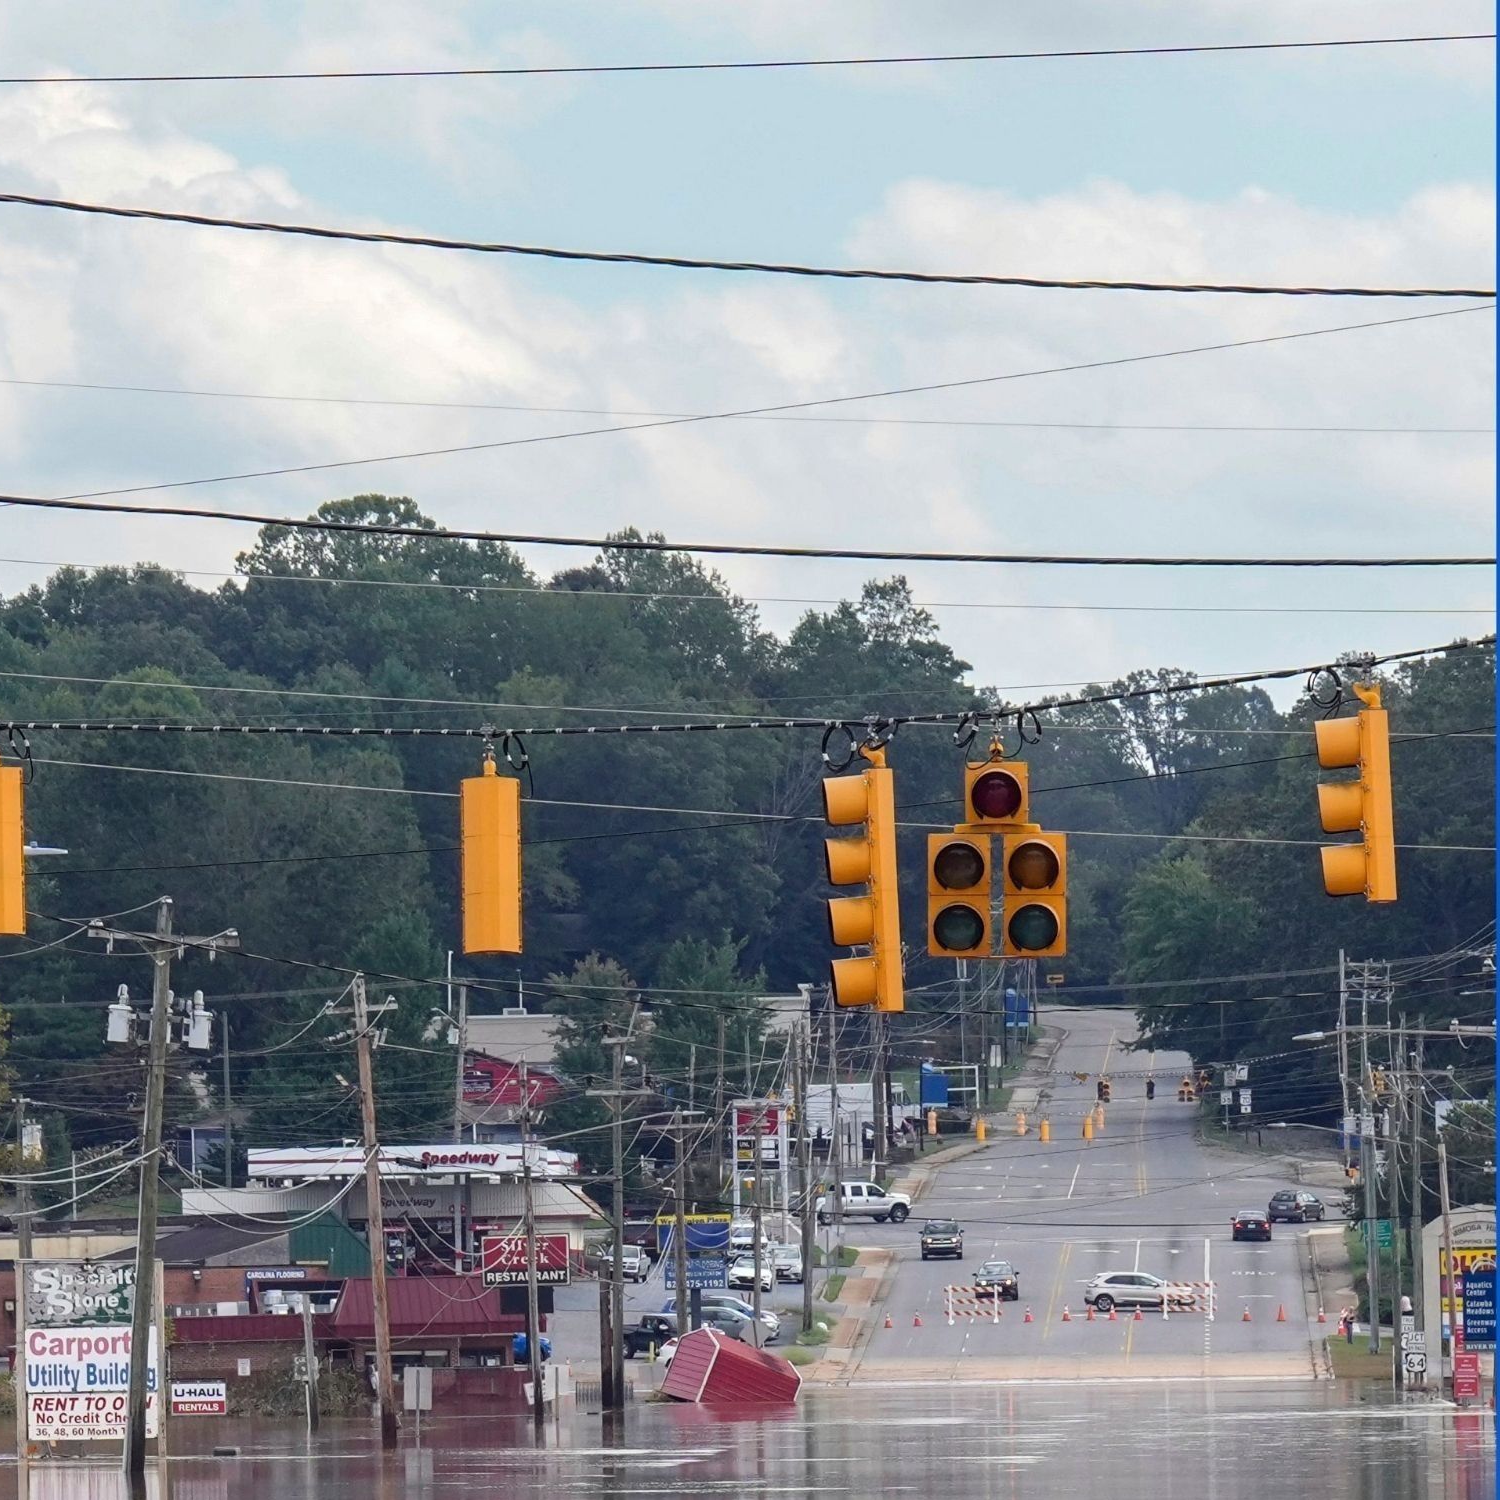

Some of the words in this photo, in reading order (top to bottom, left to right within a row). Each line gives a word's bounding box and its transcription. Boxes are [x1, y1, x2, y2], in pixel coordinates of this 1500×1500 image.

[422, 1152, 500, 1166] Speedway
[33, 1268, 136, 1293] Specialt
[246, 1271, 276, 1279] CAROLINA
[276, 1271, 305, 1279] FLOORING
[1466, 1281, 1492, 1289] Aquatics
[1466, 1289, 1487, 1297] Center
[46, 1290, 120, 1315] Stone
[1466, 1319, 1497, 1327] Greenway
[1409, 1333, 1424, 1342] JCT
[29, 1331, 131, 1361] Carport
[1408, 1358, 1424, 1369] 64
[28, 1364, 80, 1391] Utility
[86, 1362, 156, 1392] Buildg
[32, 1397, 79, 1412] RENT
[85, 1397, 106, 1411] TO
[178, 1403, 219, 1412] RENTALS
[36, 1413, 54, 1424] No
[58, 1412, 100, 1424] Credit
[35, 1428, 51, 1437] 36,
[54, 1428, 69, 1437] 48,
[72, 1427, 84, 1436] 60
[87, 1427, 118, 1436] Month
